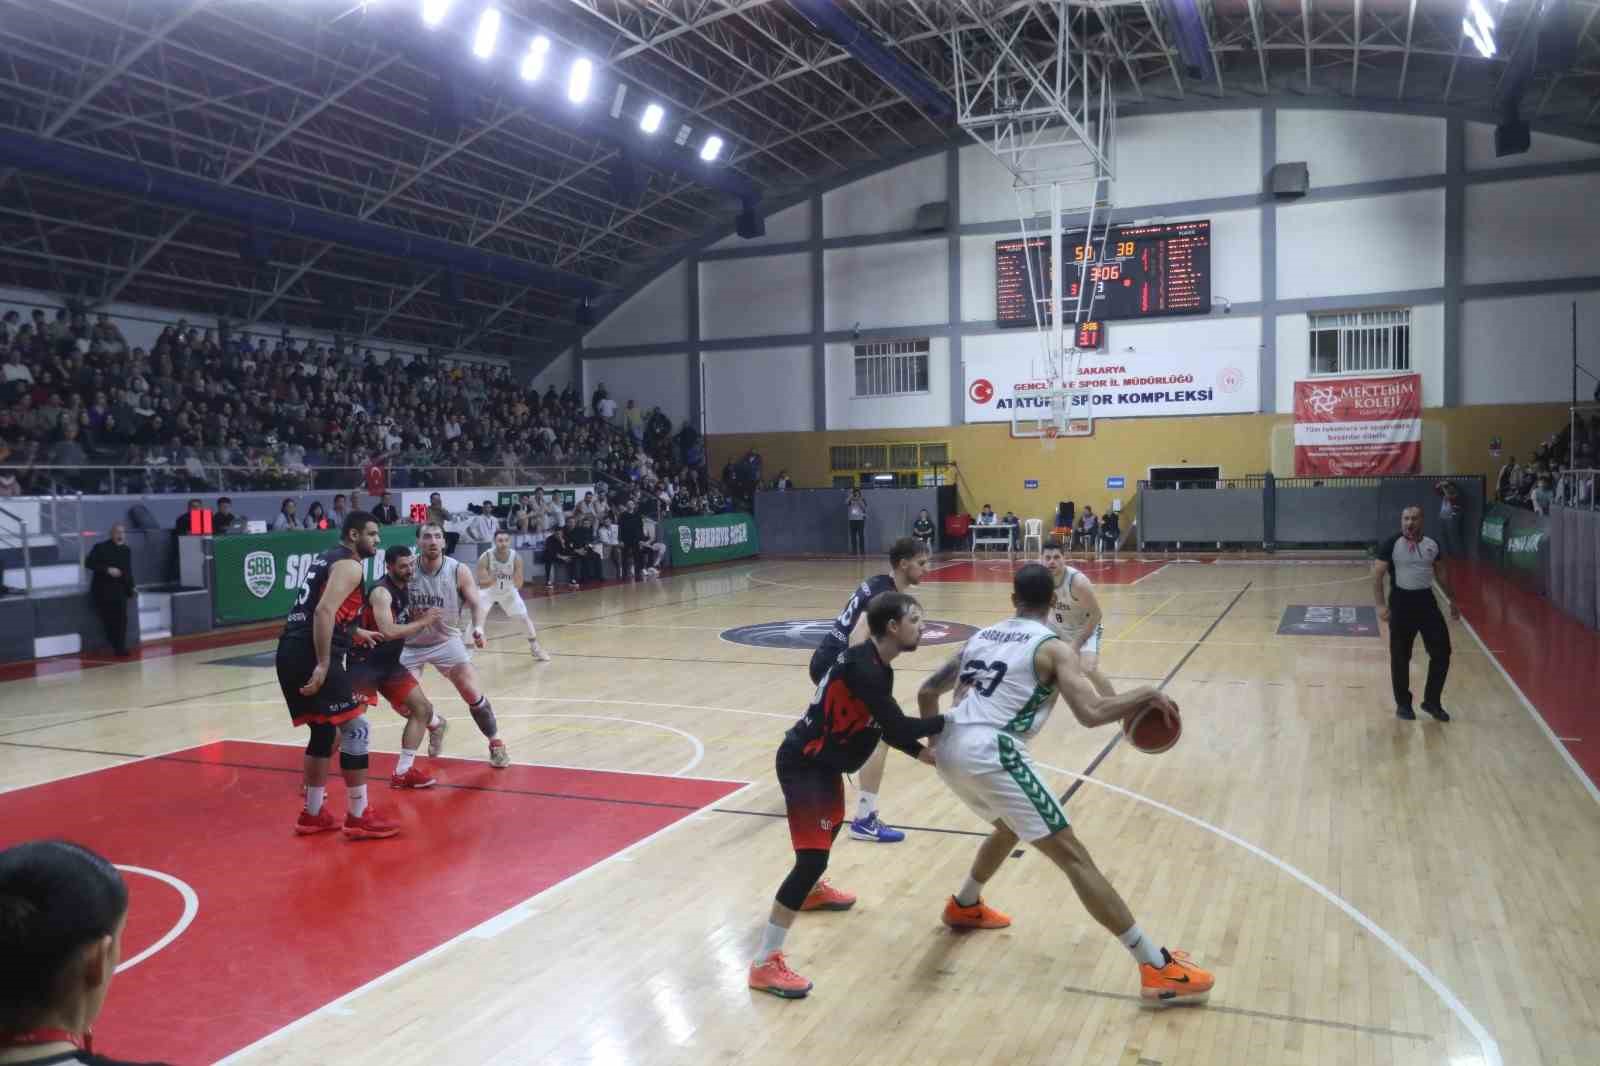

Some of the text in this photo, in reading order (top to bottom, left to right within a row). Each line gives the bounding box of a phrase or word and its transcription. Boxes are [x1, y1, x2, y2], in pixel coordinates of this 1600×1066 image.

[1075, 244, 1094, 261] 50
[1116, 241, 1135, 257] 38
[1090, 265, 1120, 282] 3:06
[1079, 379, 1107, 388] SPOR
[1123, 374, 1194, 386] MÜDÜRLÜĞÜ
[1071, 393, 1113, 407] SPOR
[1118, 386, 1213, 404] KOMPLEKSİ
[247, 557, 273, 576] SBB
